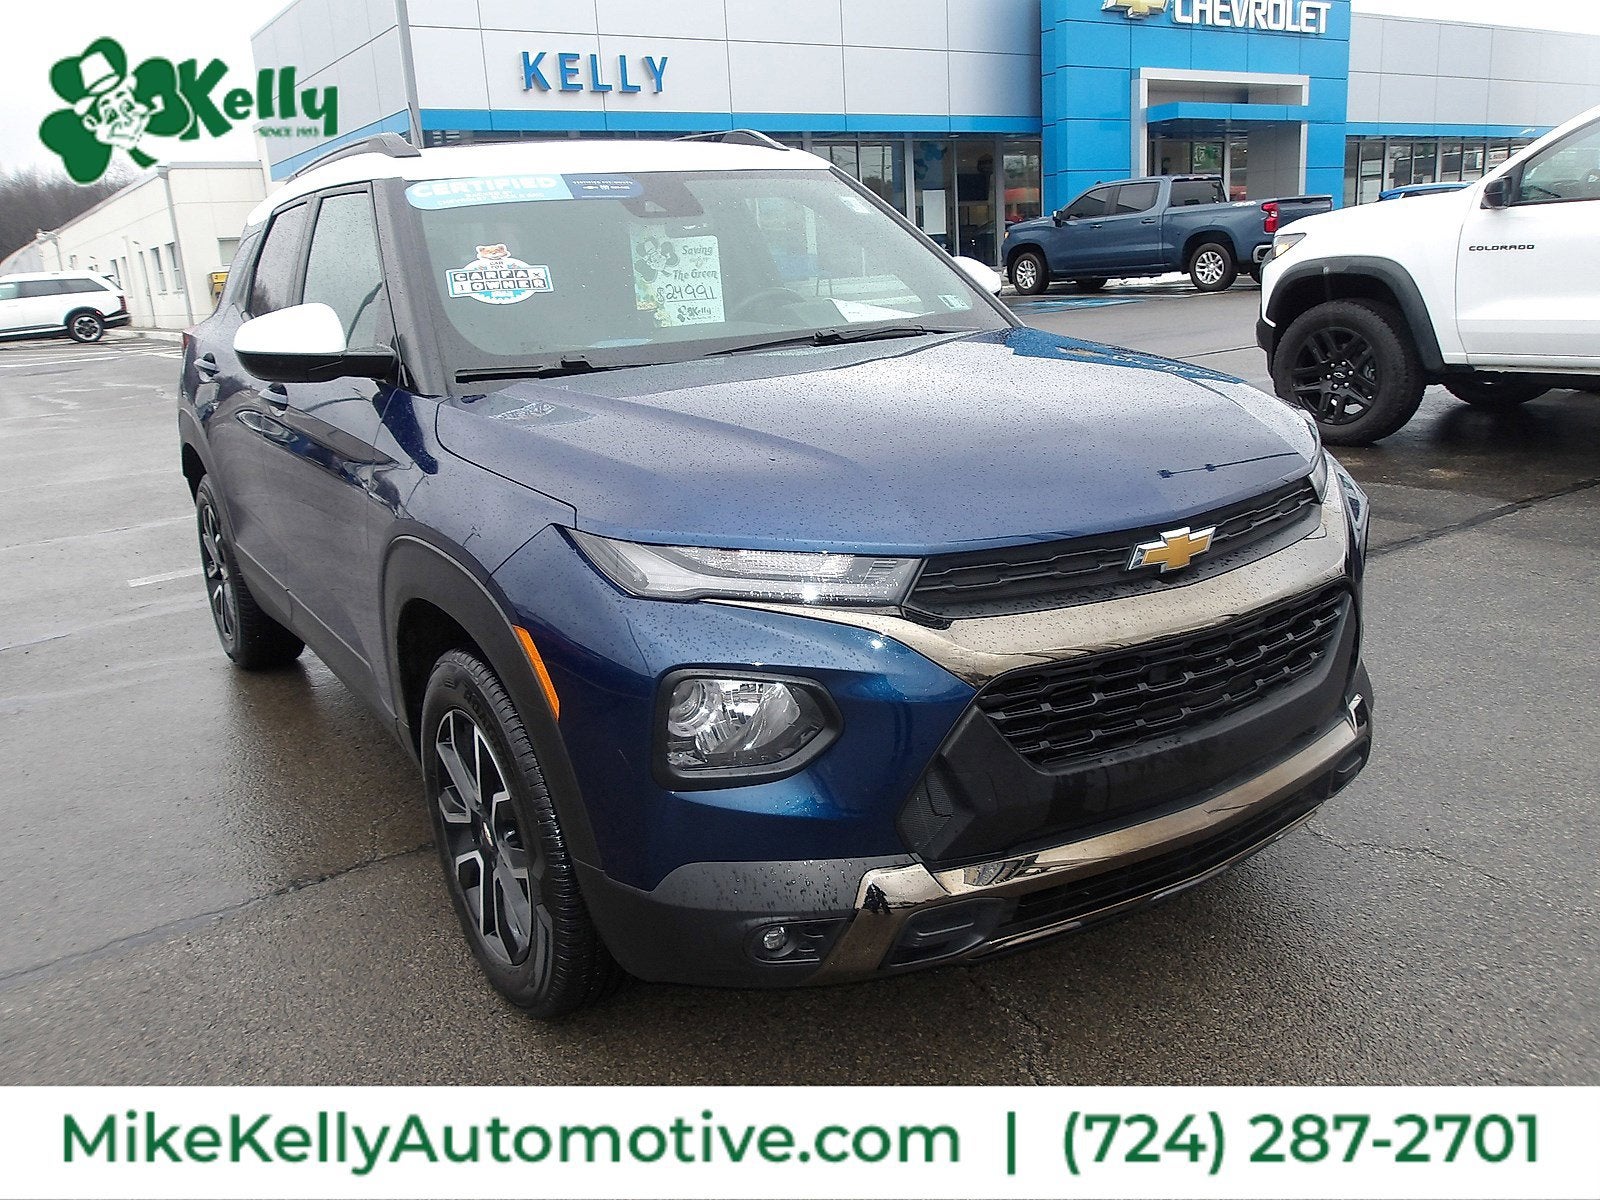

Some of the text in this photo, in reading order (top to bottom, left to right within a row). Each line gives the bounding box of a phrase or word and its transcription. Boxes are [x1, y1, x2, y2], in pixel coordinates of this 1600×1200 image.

[1172, 0, 1331, 34] CHEVROLET
[520, 51, 669, 93] KELLY
[411, 177, 557, 198] CERTIFIED
[681, 245, 713, 256] Saving
[1468, 244, 1536, 252] COLORADO
[453, 269, 541, 281] CARFAX
[672, 268, 719, 281] The Green
[470, 279, 547, 292] OWNER
